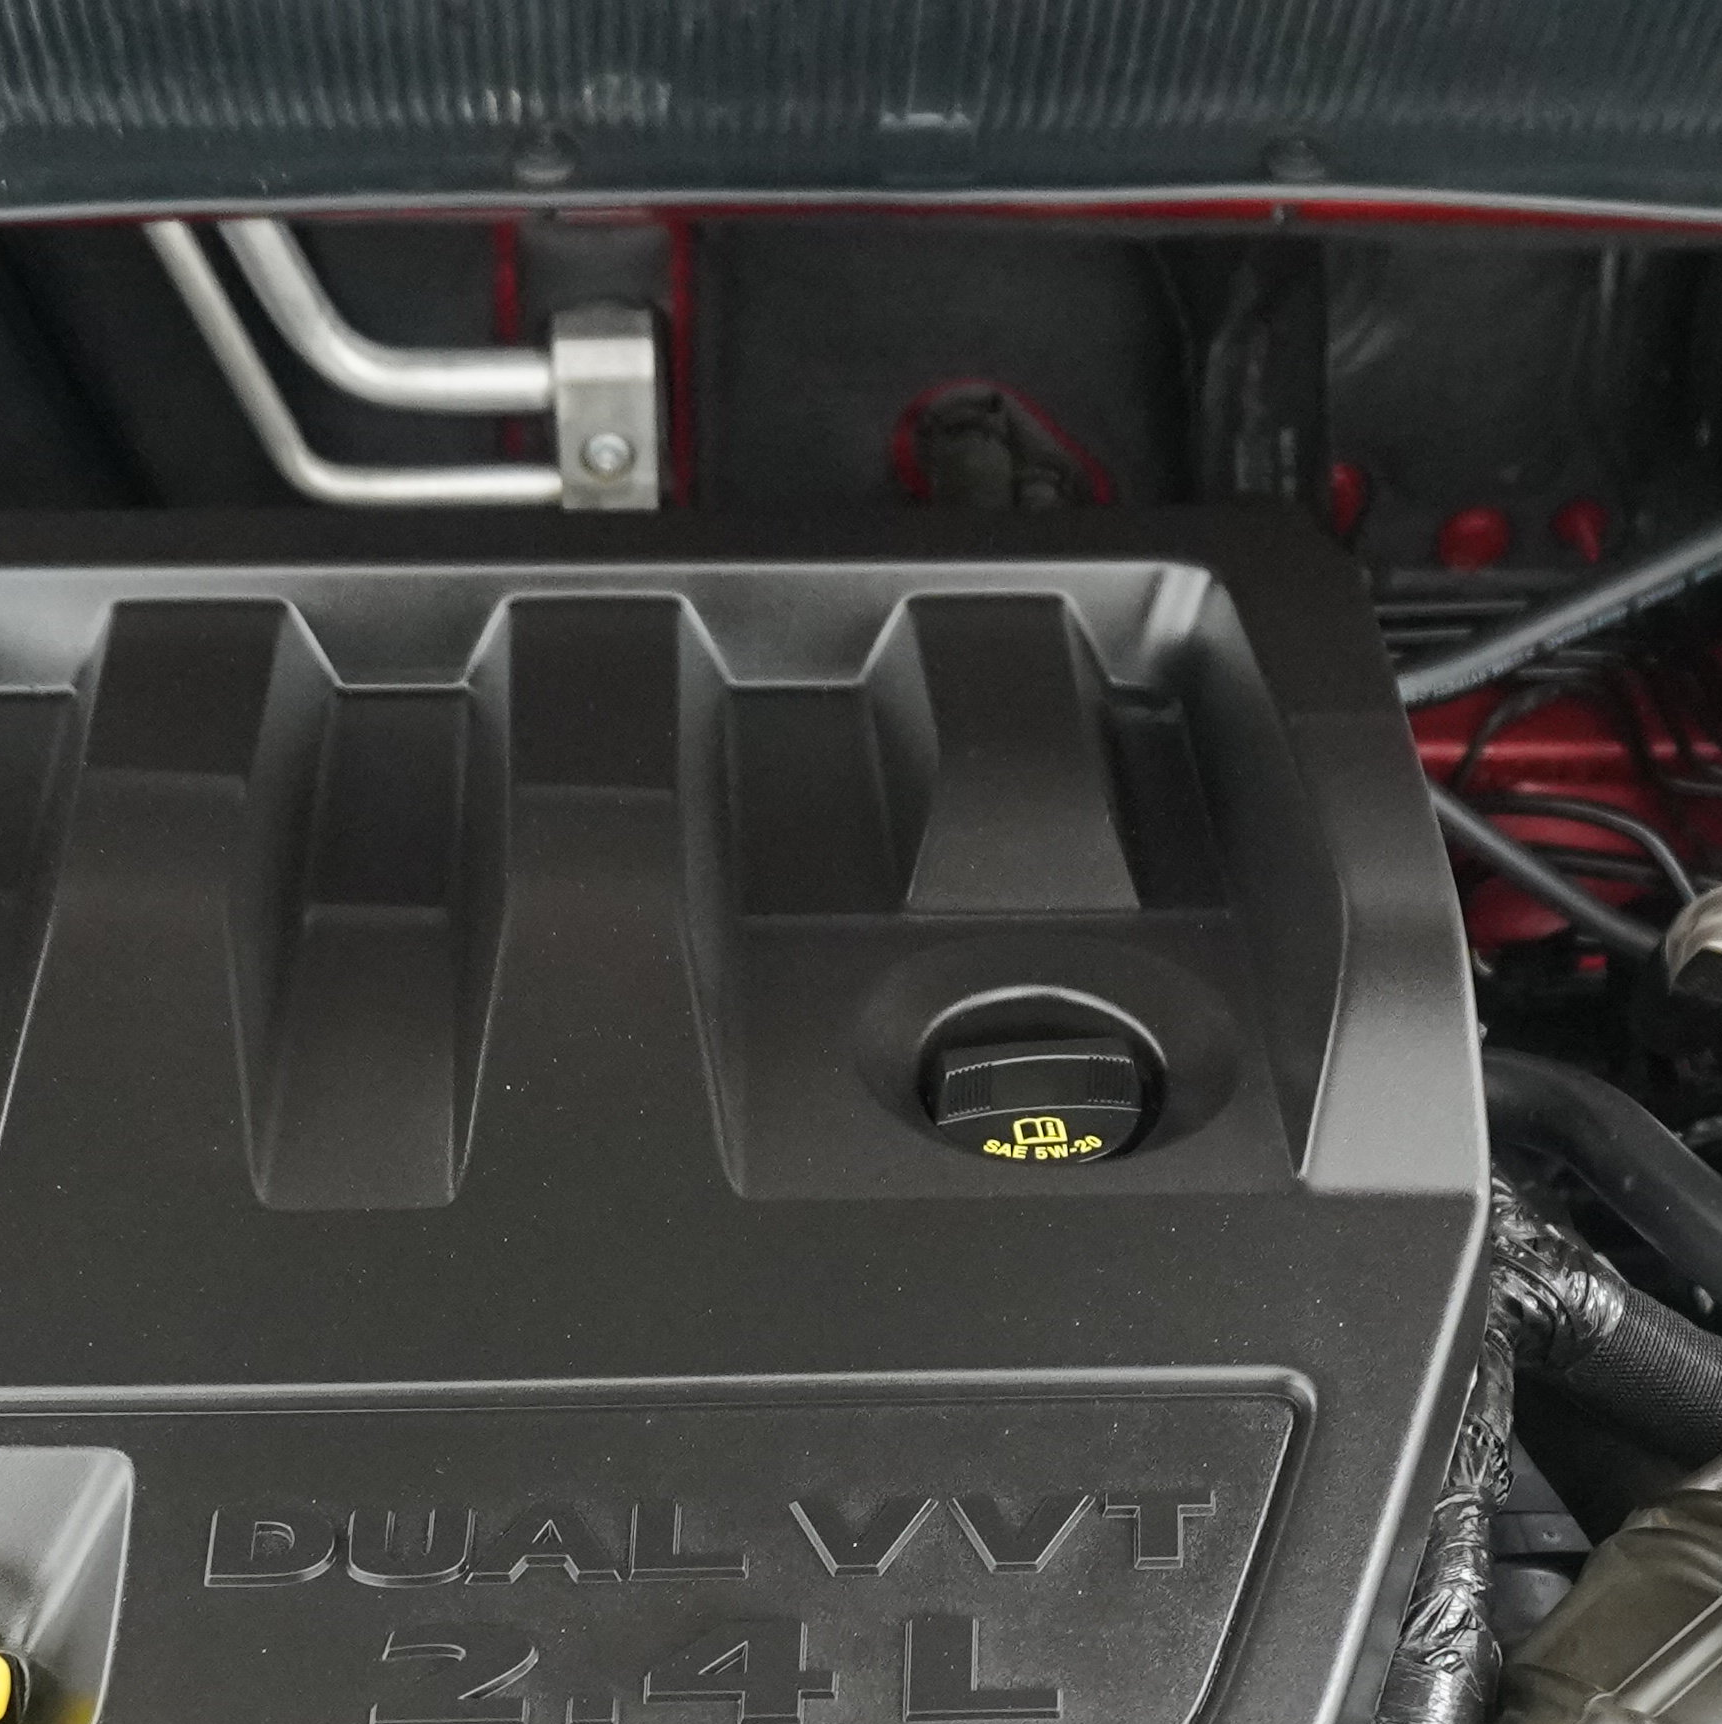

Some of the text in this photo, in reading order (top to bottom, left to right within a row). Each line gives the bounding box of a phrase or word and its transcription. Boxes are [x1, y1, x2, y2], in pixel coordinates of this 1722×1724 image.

[982, 1134, 1104, 1161] SAE 5W-20
[204, 1490, 1216, 1588] DUAL VVT
